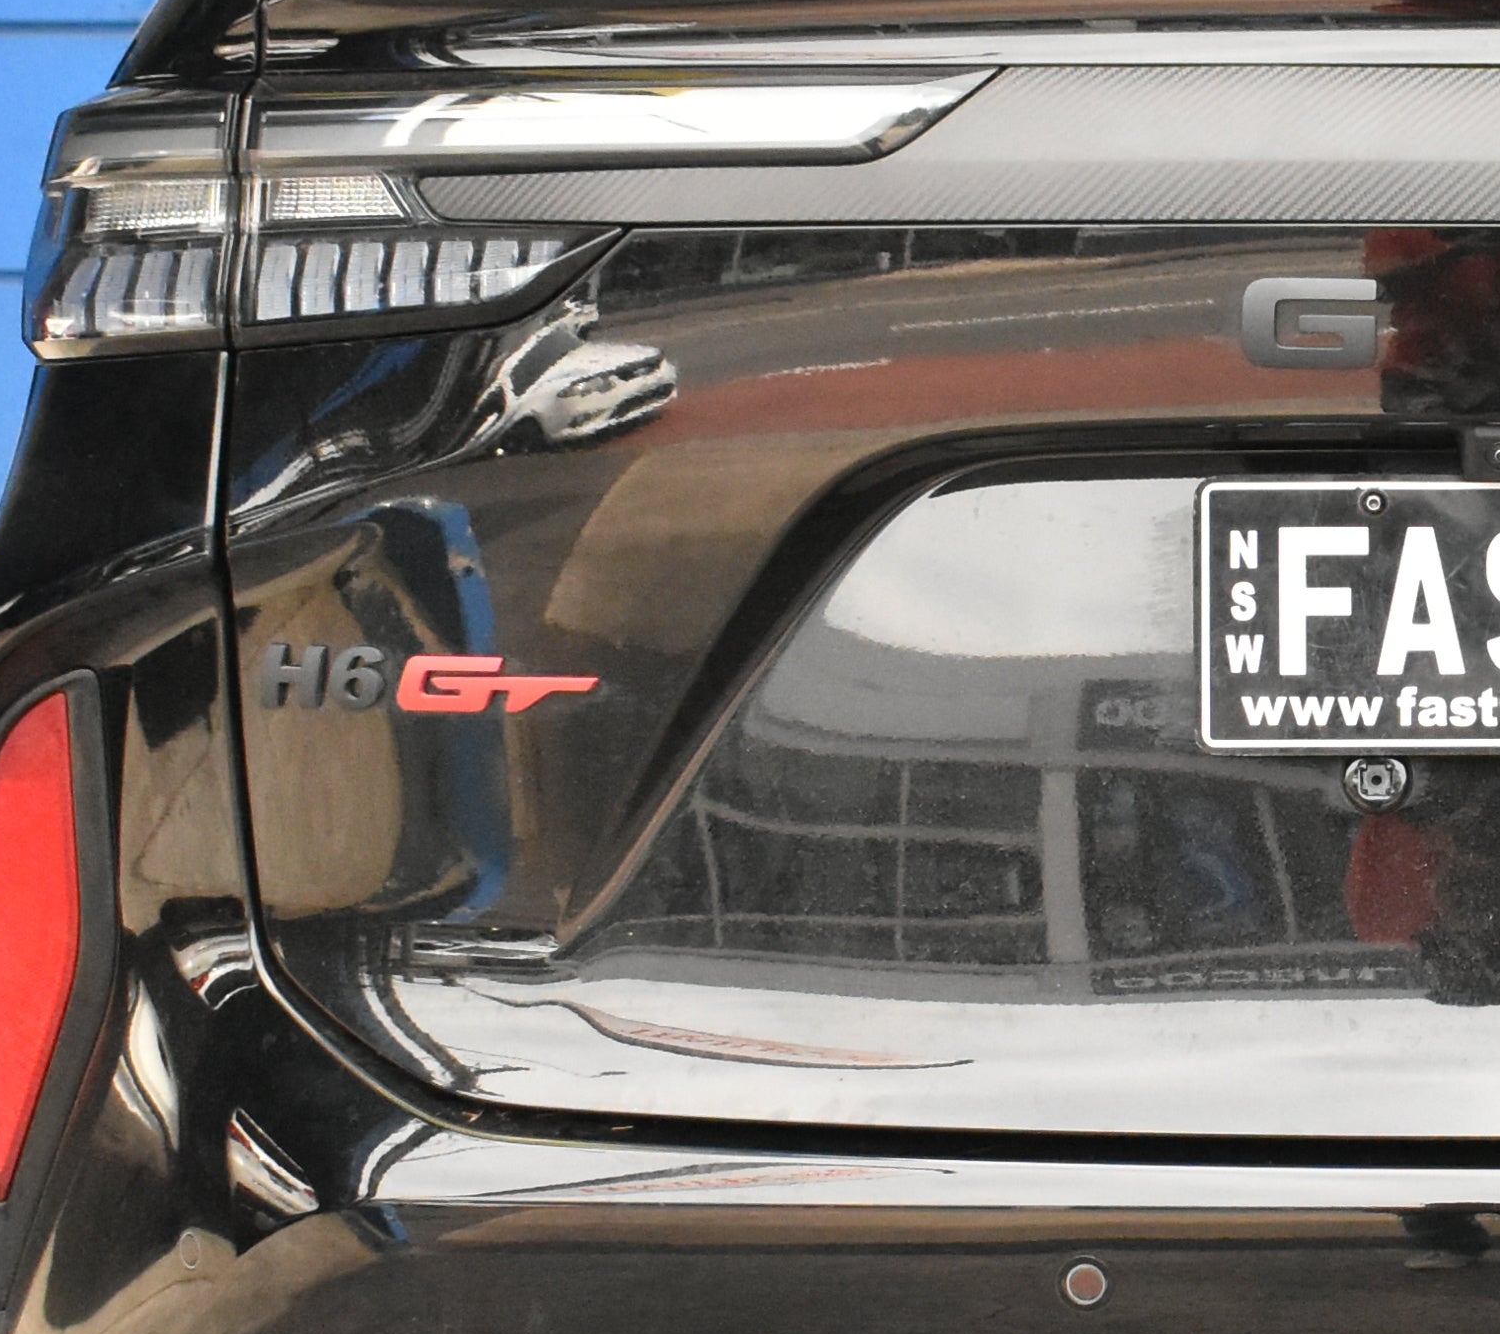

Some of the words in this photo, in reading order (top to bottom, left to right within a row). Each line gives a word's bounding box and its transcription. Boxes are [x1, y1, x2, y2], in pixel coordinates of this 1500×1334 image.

[1226, 529, 1264, 675] NSW
[260, 642, 386, 711] H6
[396, 654, 599, 713] GT
